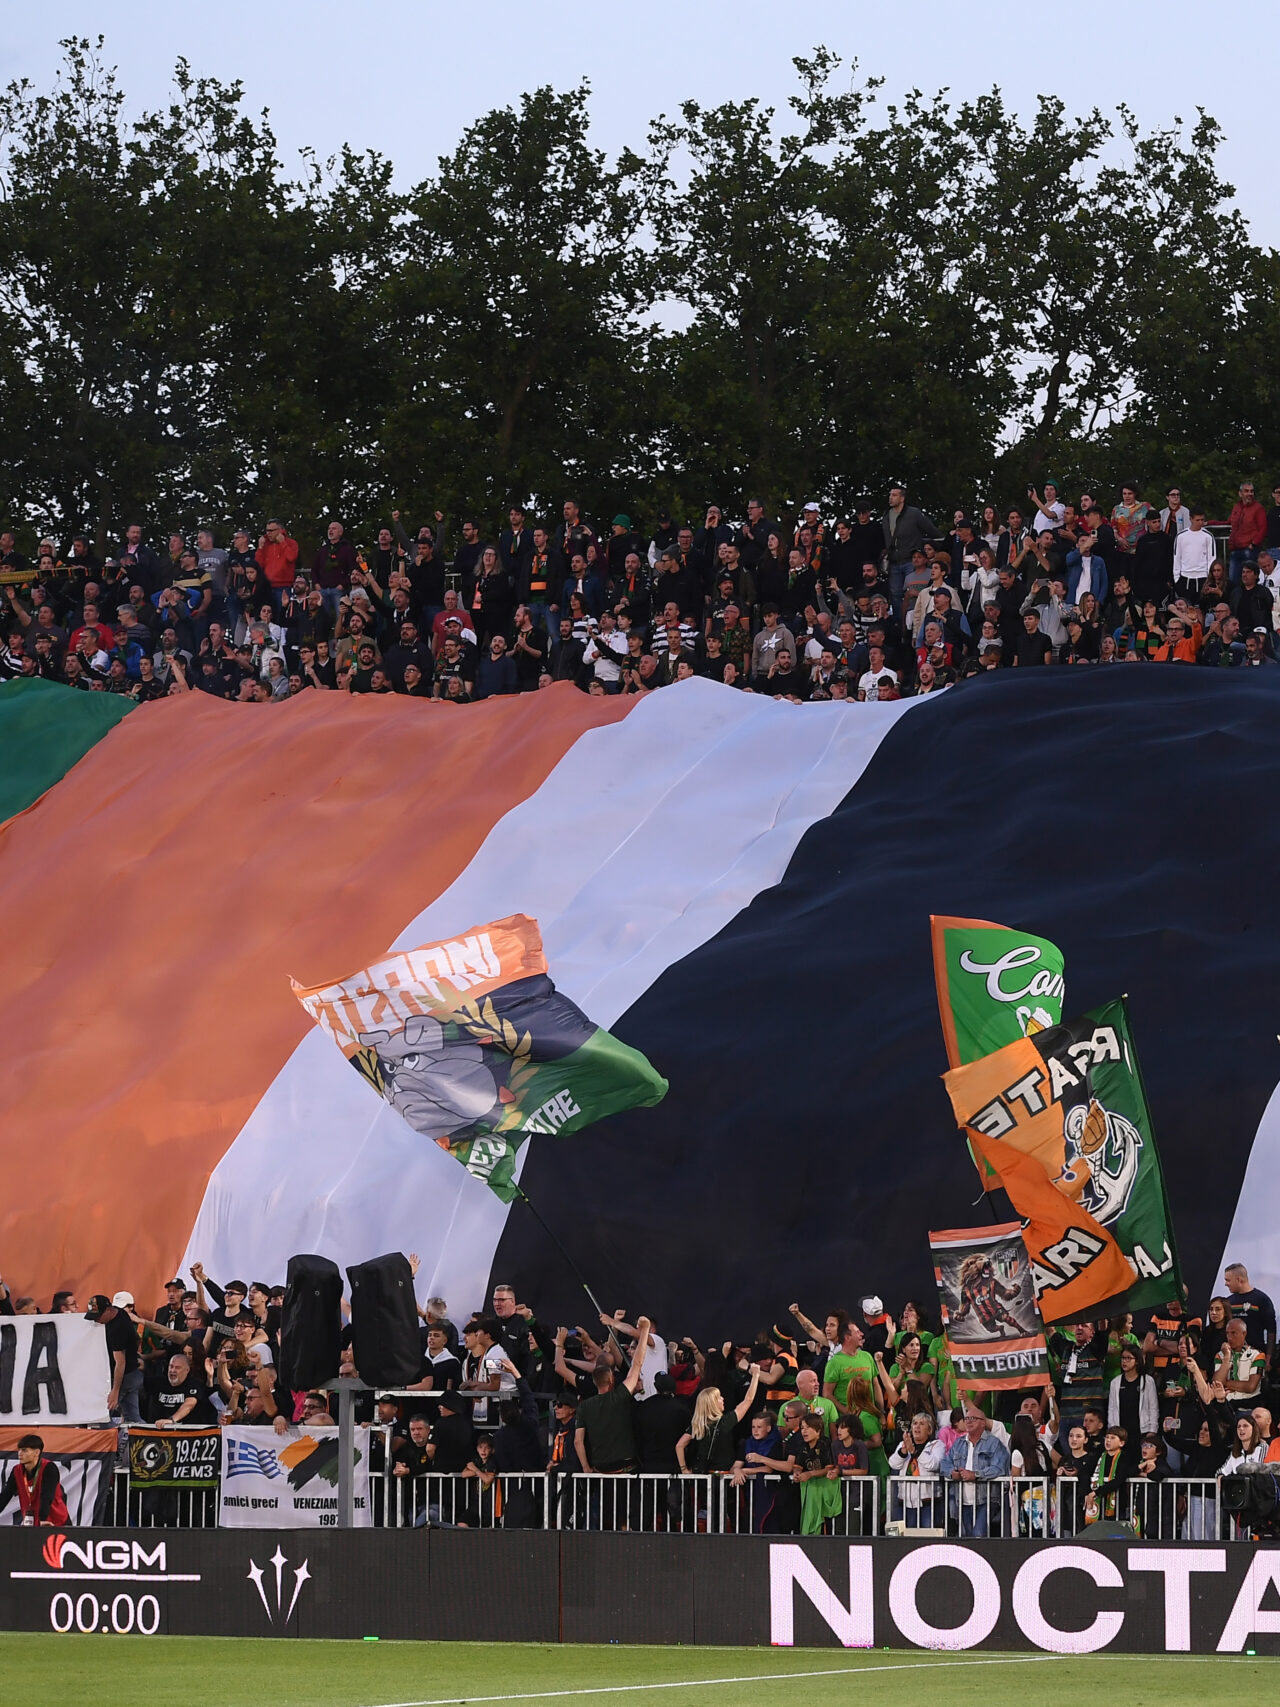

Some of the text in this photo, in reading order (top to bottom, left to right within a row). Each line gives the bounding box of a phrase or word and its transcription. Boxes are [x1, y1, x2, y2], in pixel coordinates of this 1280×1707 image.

[957, 1350, 1041, 1373] 11 LEONI
[175, 1437, 218, 1464] 19.6.22
[223, 1496, 249, 1508] amici
[251, 1496, 279, 1510] greci
[60, 1540, 167, 1571] NGM
[50, 1592, 161, 1635] 00:00
